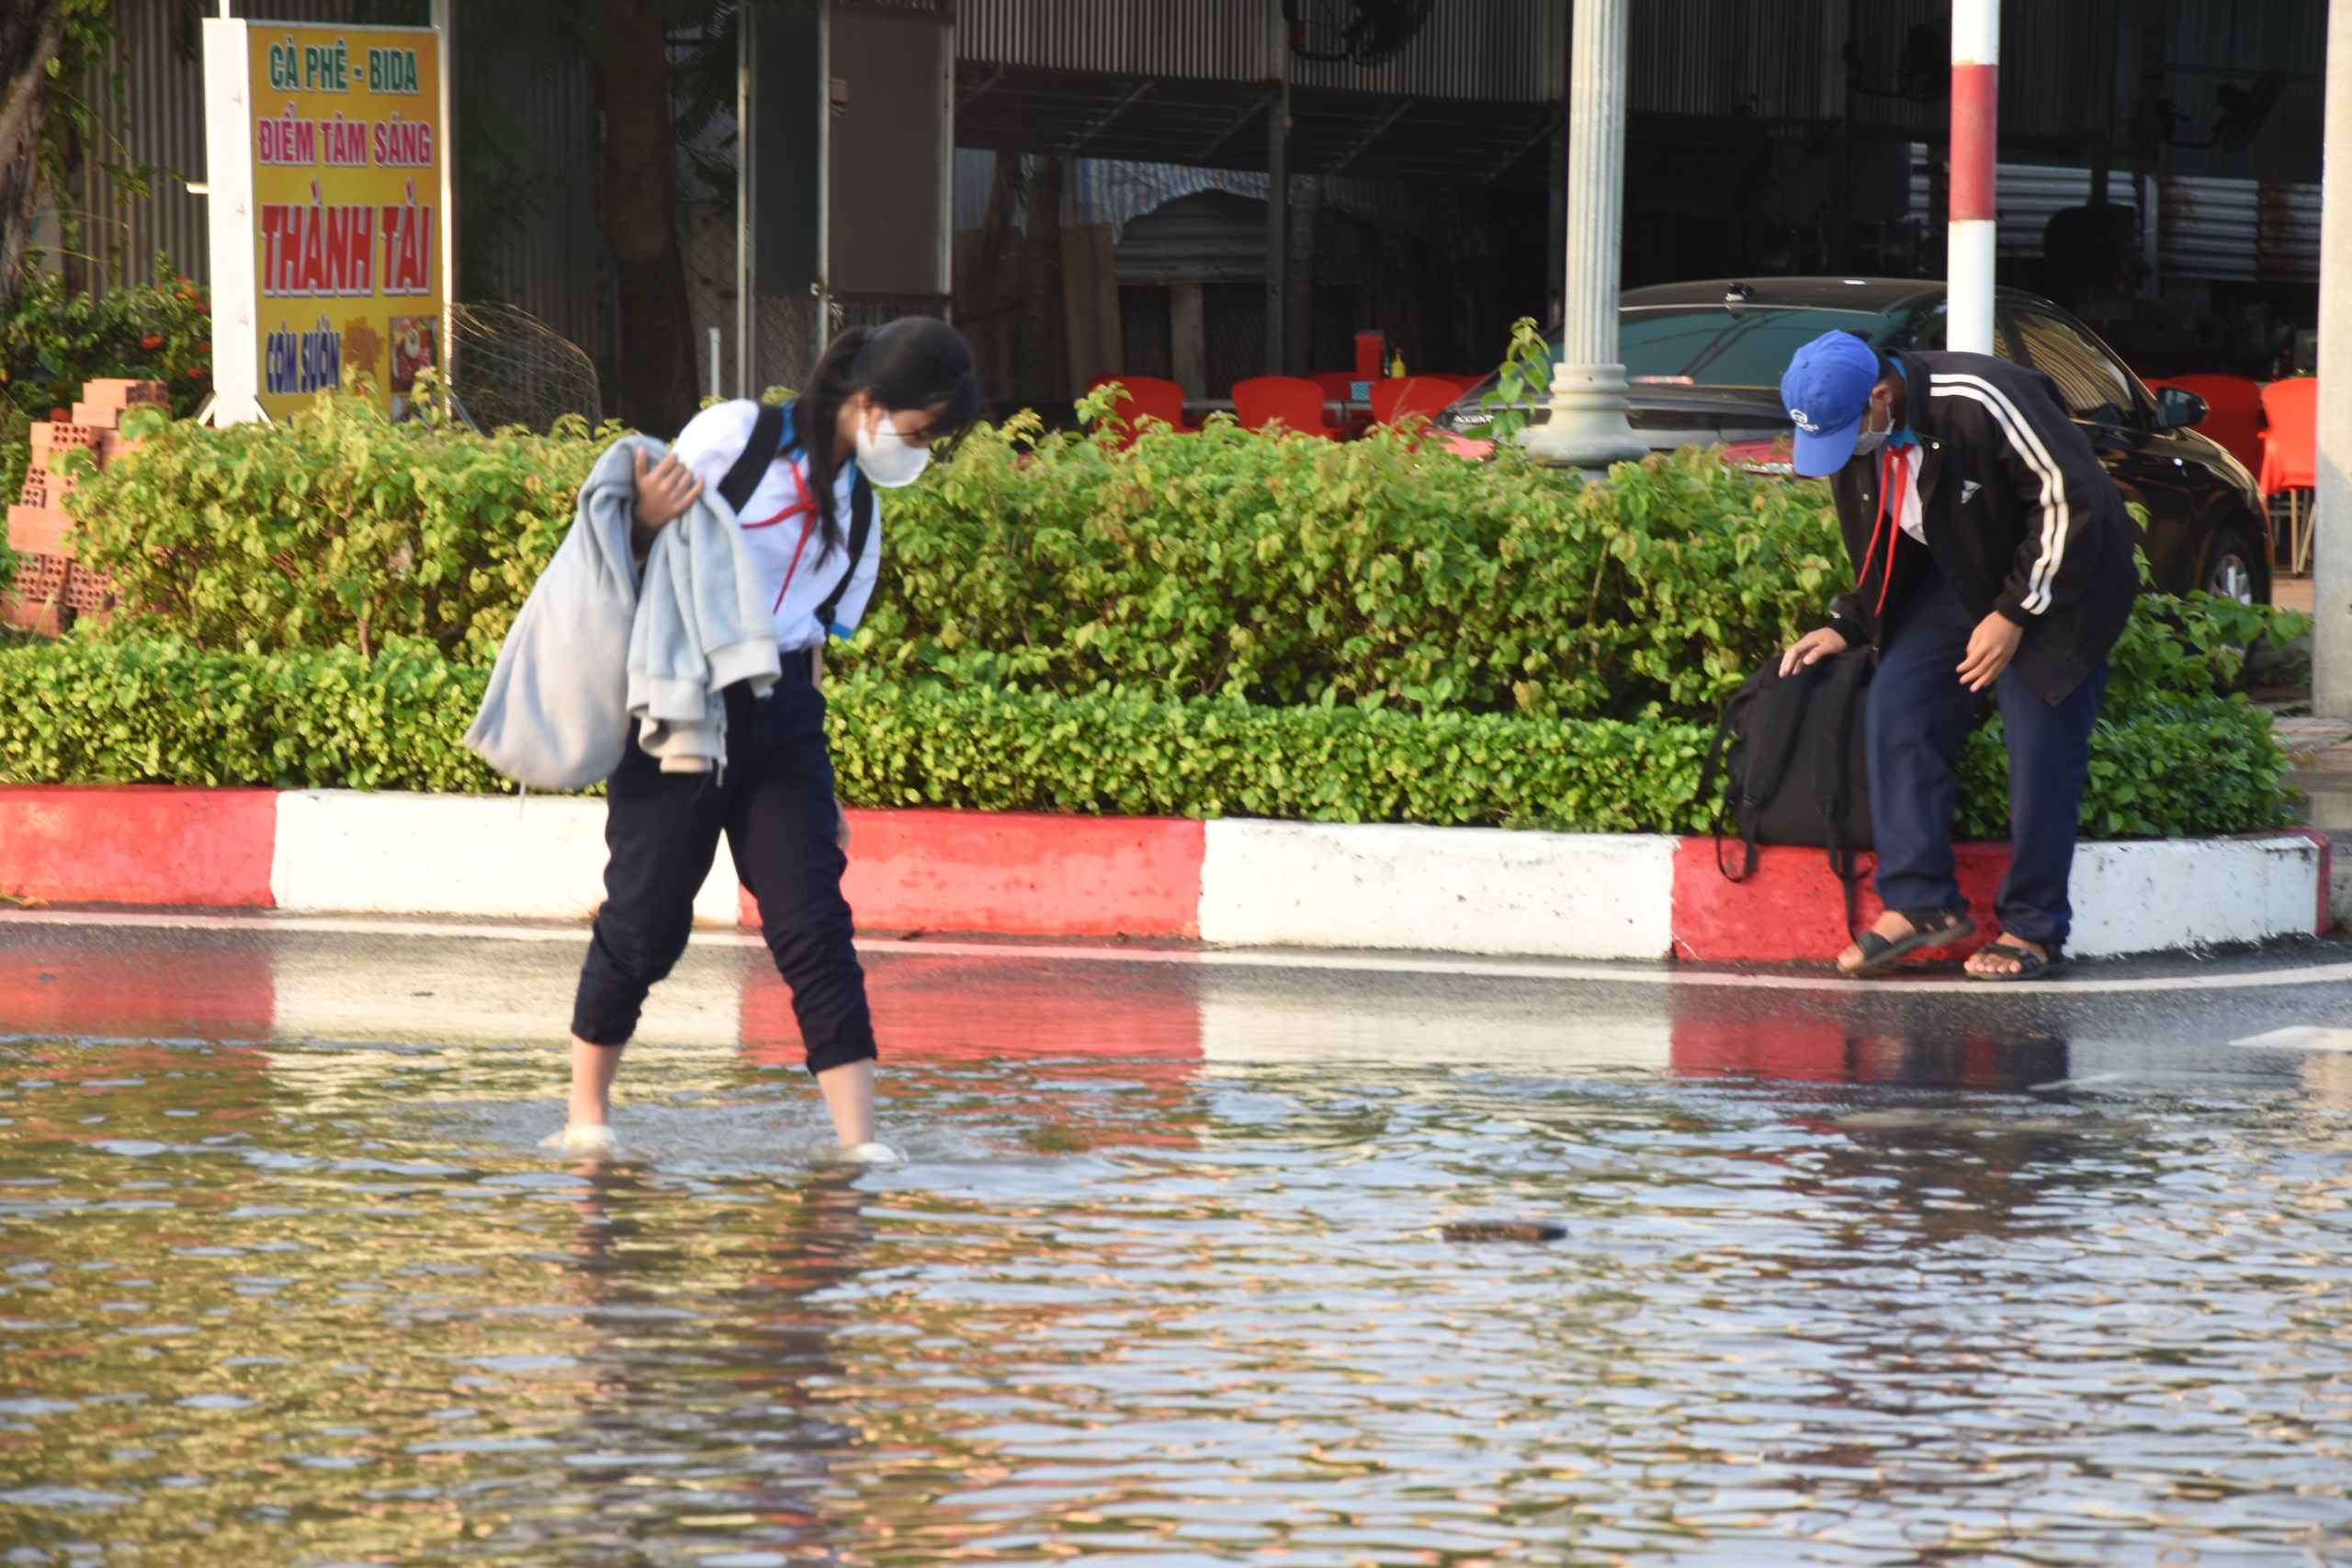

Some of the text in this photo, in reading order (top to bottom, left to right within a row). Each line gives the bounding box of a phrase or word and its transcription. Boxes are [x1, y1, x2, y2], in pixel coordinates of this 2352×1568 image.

[270, 35, 300, 91] CÀ
[305, 38, 348, 92] PHÊ
[368, 49, 420, 94] BIDA
[258, 102, 433, 166] ĐIỂM TÂM SÁNG
[262, 176, 433, 296] THÀNH TÀI
